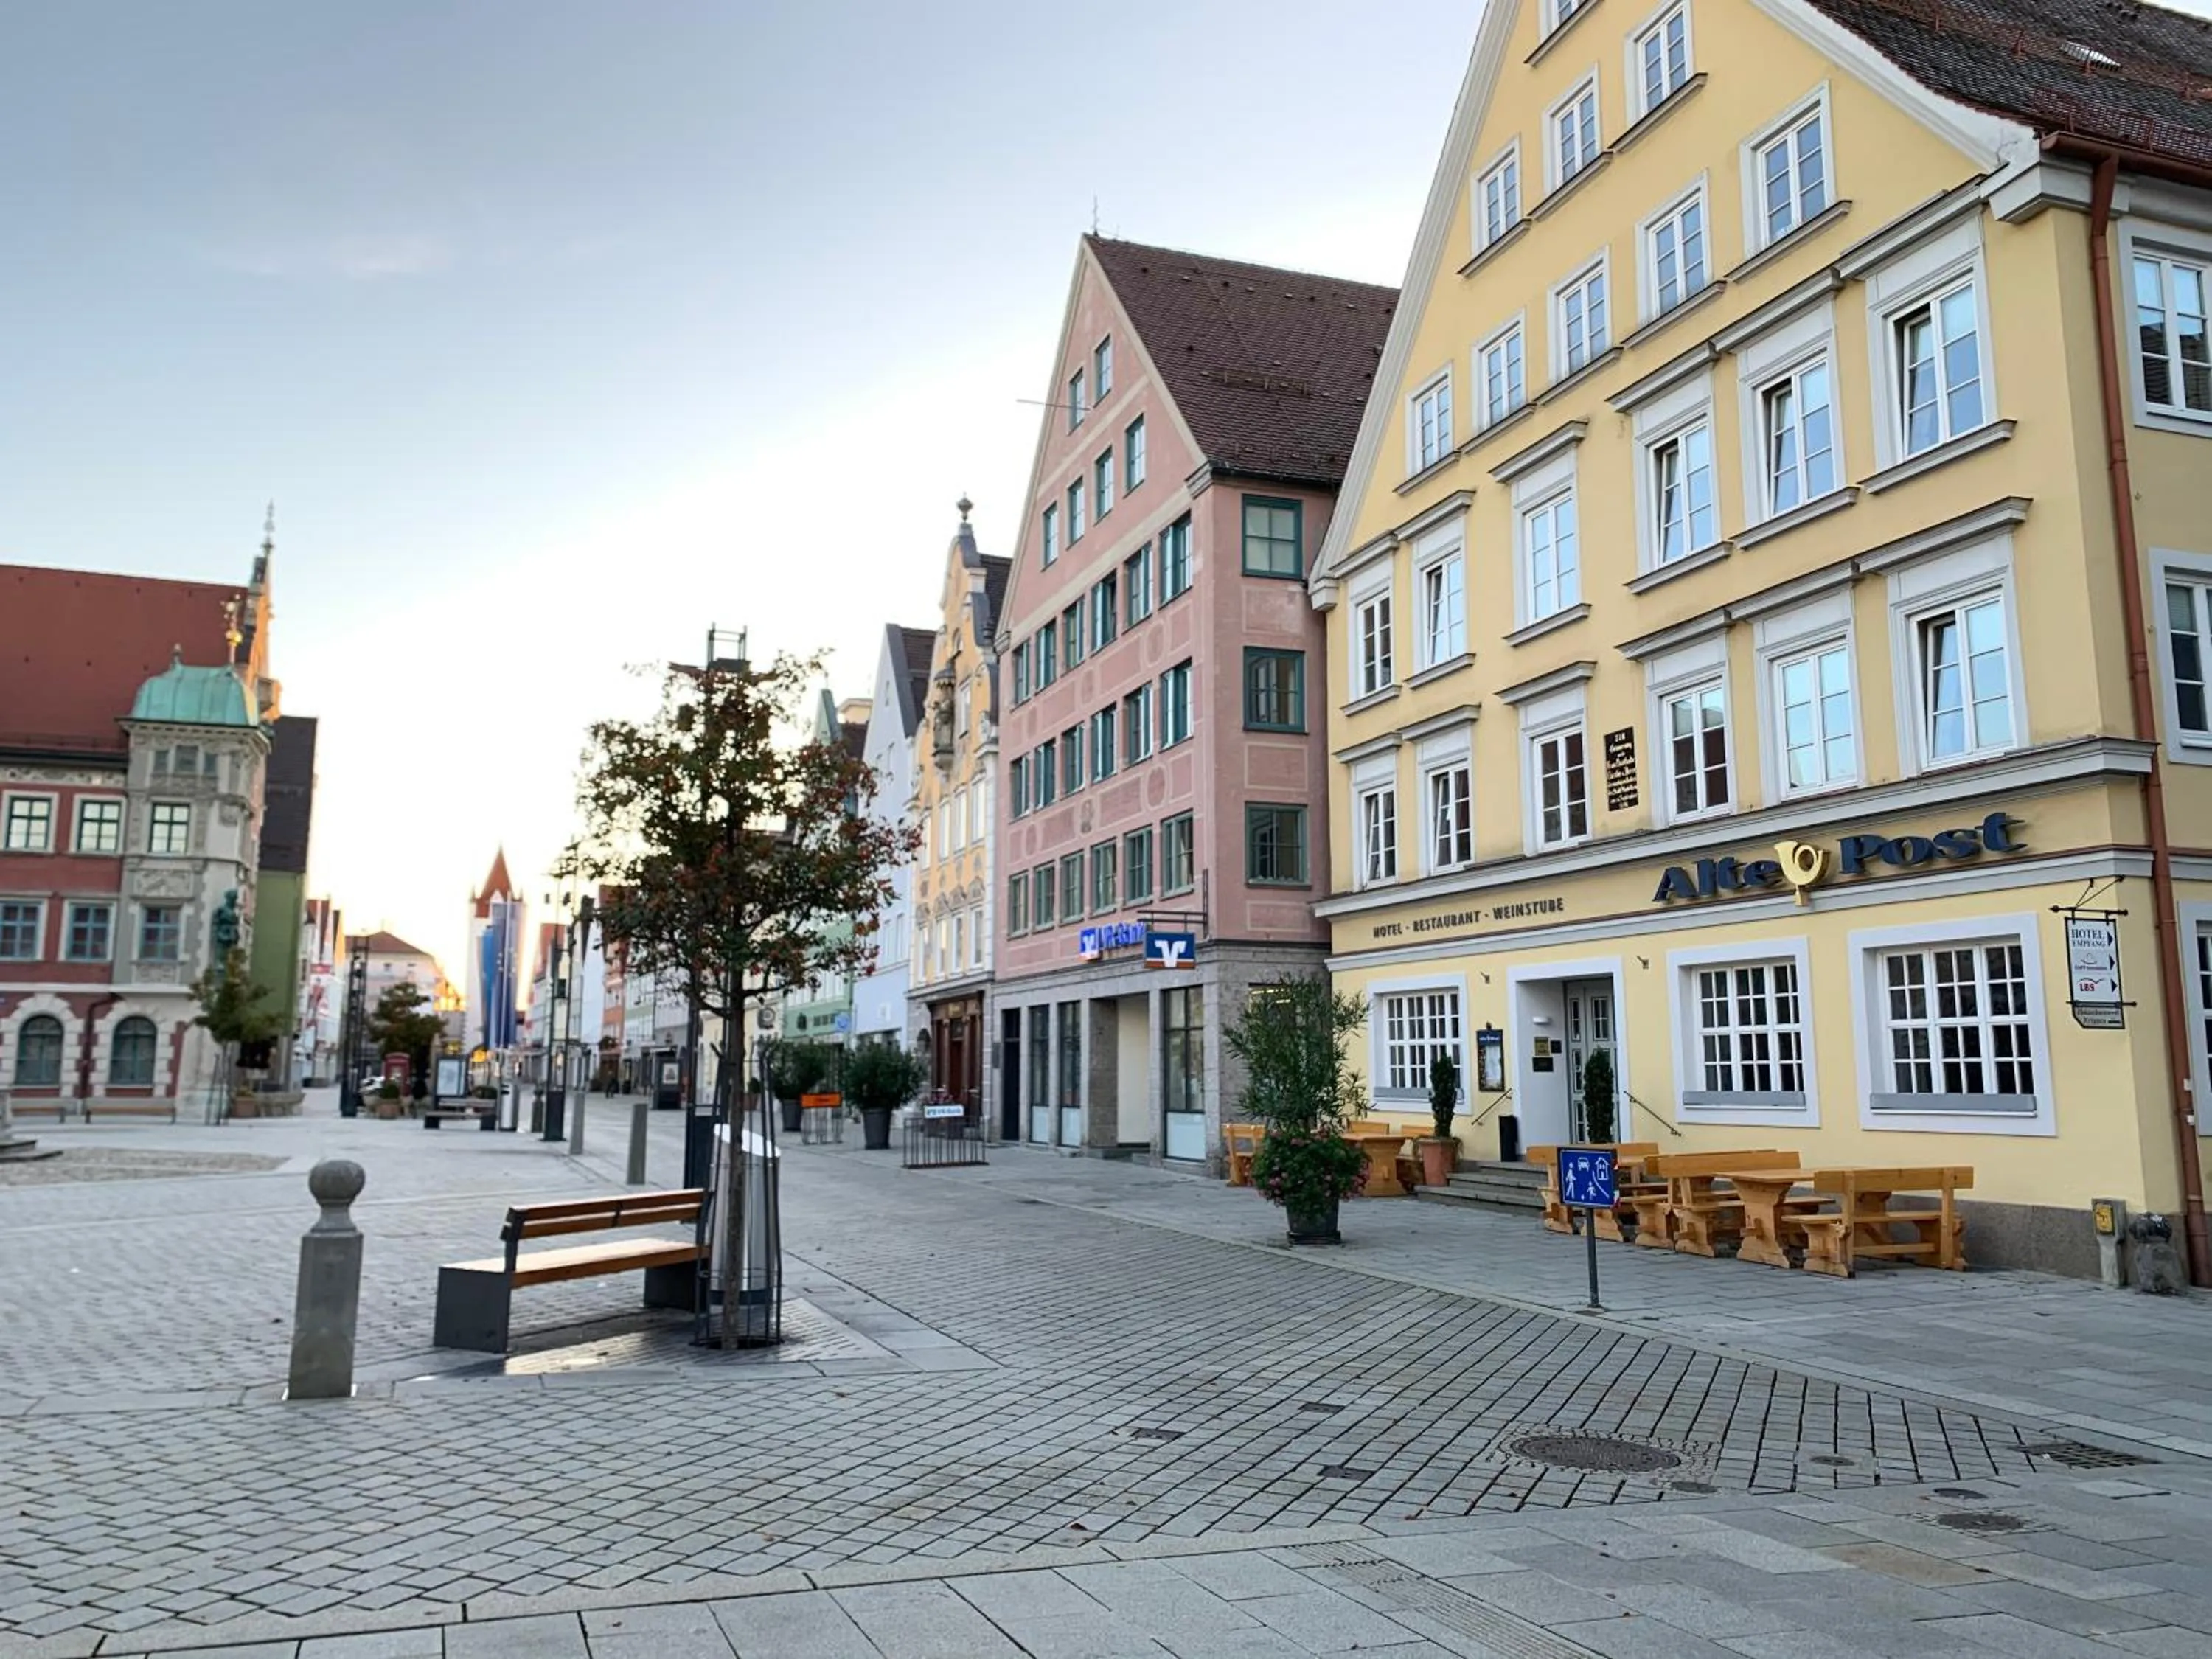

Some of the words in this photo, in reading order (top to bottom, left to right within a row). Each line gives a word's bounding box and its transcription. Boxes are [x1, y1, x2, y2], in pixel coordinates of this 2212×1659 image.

[1652, 856, 1783, 902] Alte
[1837, 812, 2028, 874] Post
[1373, 922, 1402, 938] HOTEL
[1413, 911, 1481, 932] RESTAURANT
[1492, 897, 1564, 919] WEINSTUBE
[2071, 928, 2105, 939] HOTEL
[2079, 983, 2095, 992] LBS
